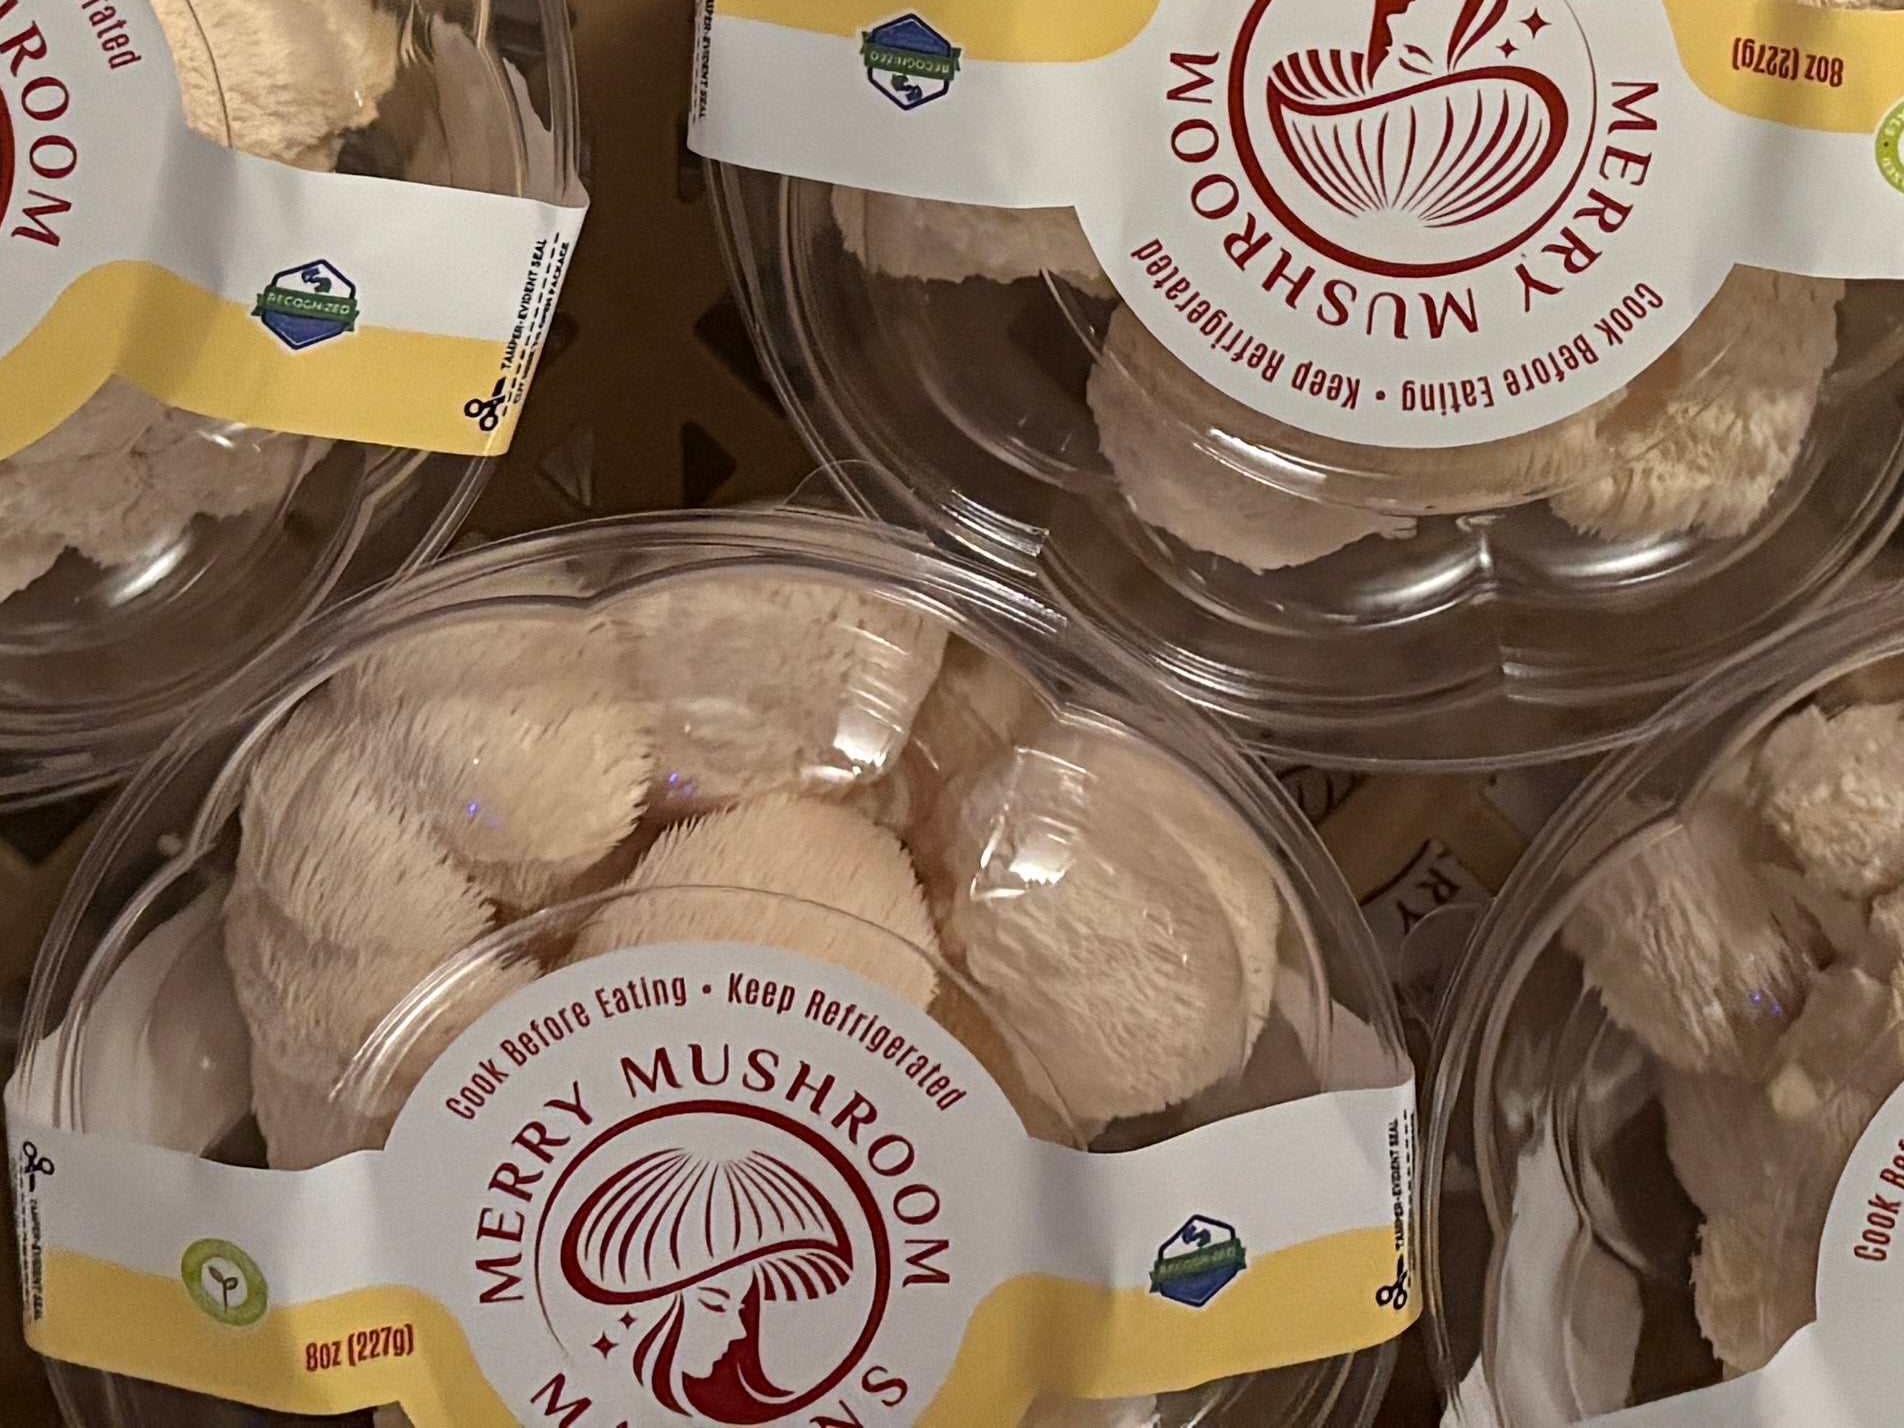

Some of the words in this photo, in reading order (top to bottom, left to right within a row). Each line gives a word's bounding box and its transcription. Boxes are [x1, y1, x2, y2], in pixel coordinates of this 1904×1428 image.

[1731, 37, 1800, 81] (227g)
[1804, 53, 1844, 89] 8oz
[1166, 53, 1478, 338] MUSHROOM
[1515, 82, 1659, 309] MERRY
[501, 270, 538, 370] TAMPER-EVIDENT
[1132, 240, 1284, 382] Refrigerated
[1595, 284, 1663, 343] Cook
[1292, 362, 1360, 408] Keep
[1402, 377, 1494, 414] Eating
[1503, 334, 1599, 396] Before
[446, 1061, 507, 1120] Cook
[500, 1002, 590, 1067] Before
[595, 977, 687, 1018] Eating
[728, 974, 796, 1015] Keep
[806, 989, 966, 1110] Refrigerated
[476, 1083, 592, 1303] MERRY
[621, 1044, 950, 1285] MUSHROOM
[1854, 1195, 1901, 1262] Cook
[305, 1340, 343, 1373] 8oz
[347, 1323, 415, 1367] (227g)
